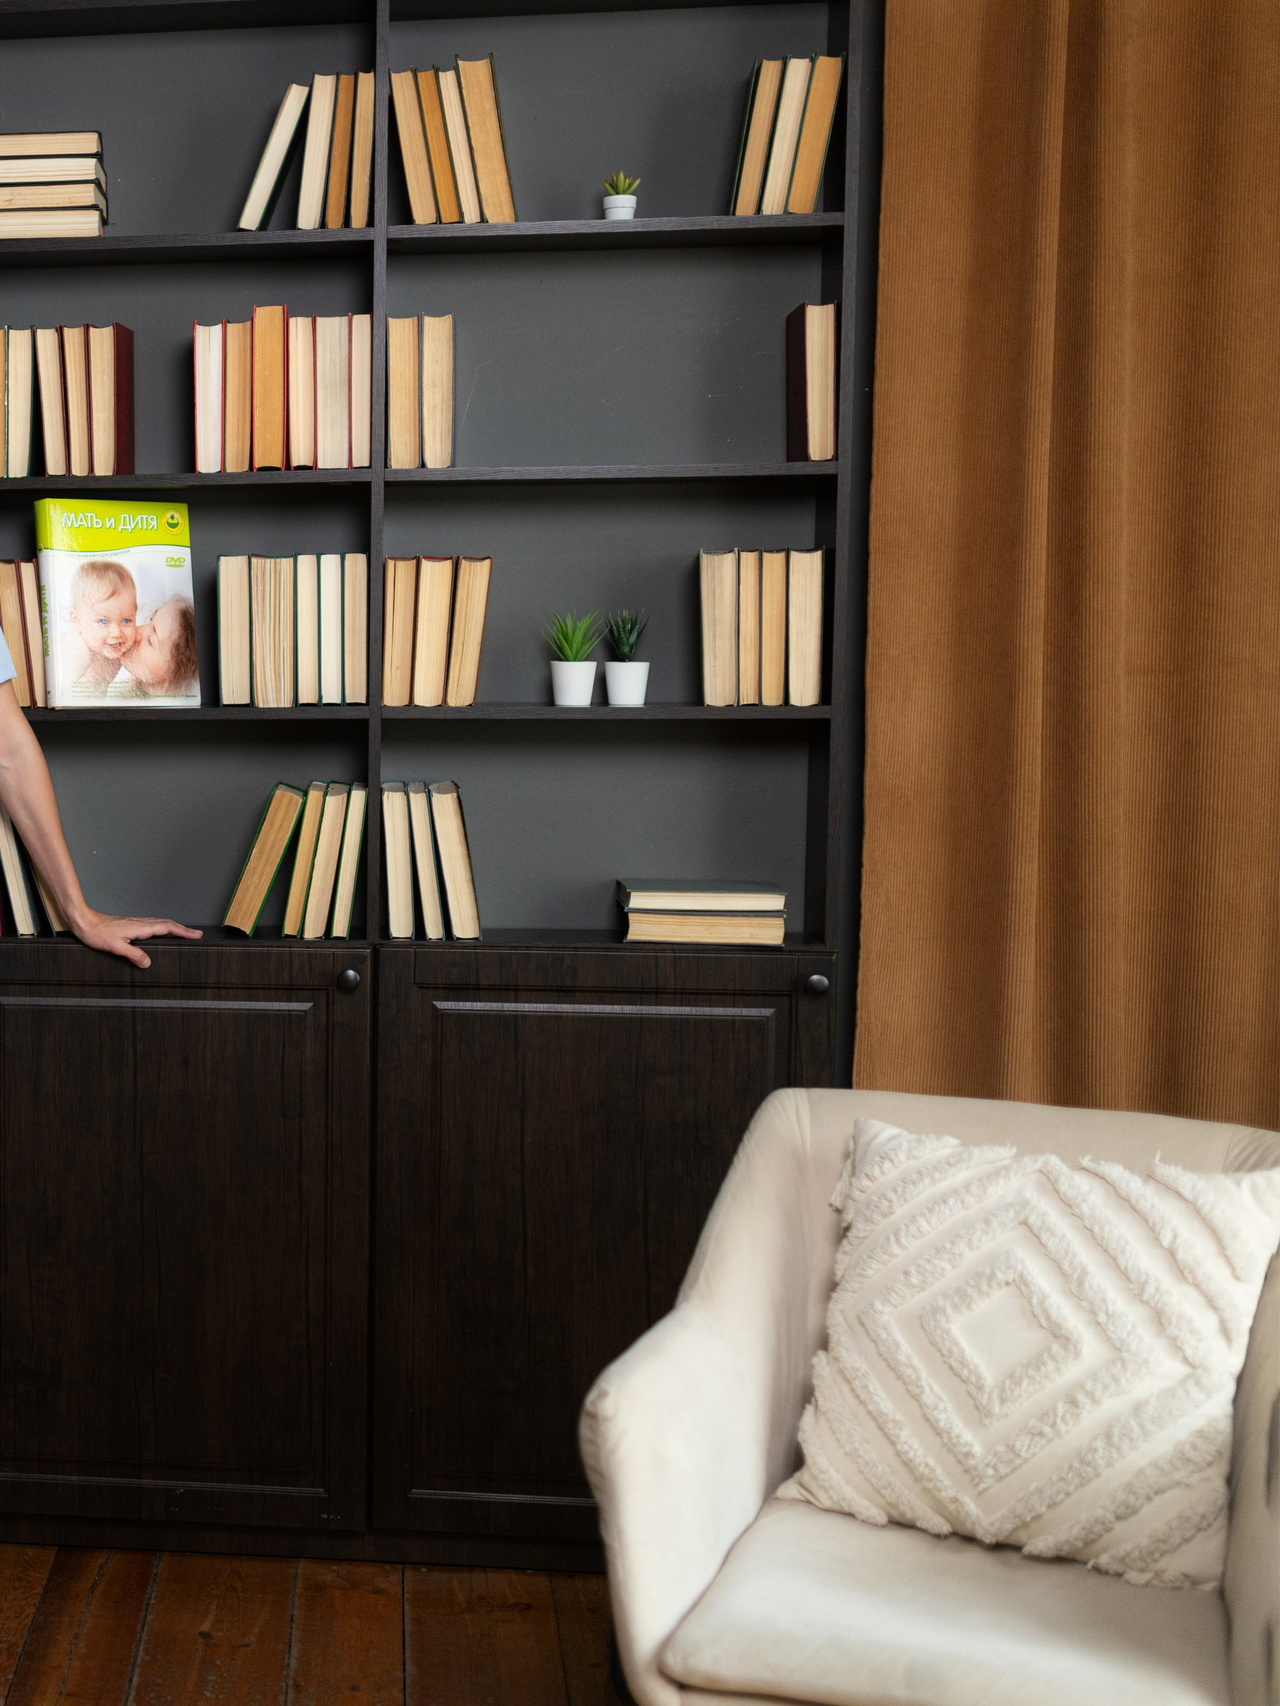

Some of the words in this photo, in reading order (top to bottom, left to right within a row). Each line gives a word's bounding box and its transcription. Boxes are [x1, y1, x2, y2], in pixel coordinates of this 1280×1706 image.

[62, 512, 103, 528] МАТЬ
[106, 517, 116, 529] и
[118, 513, 158, 533] ДИТЯ
[165, 556, 186, 564] DVD
